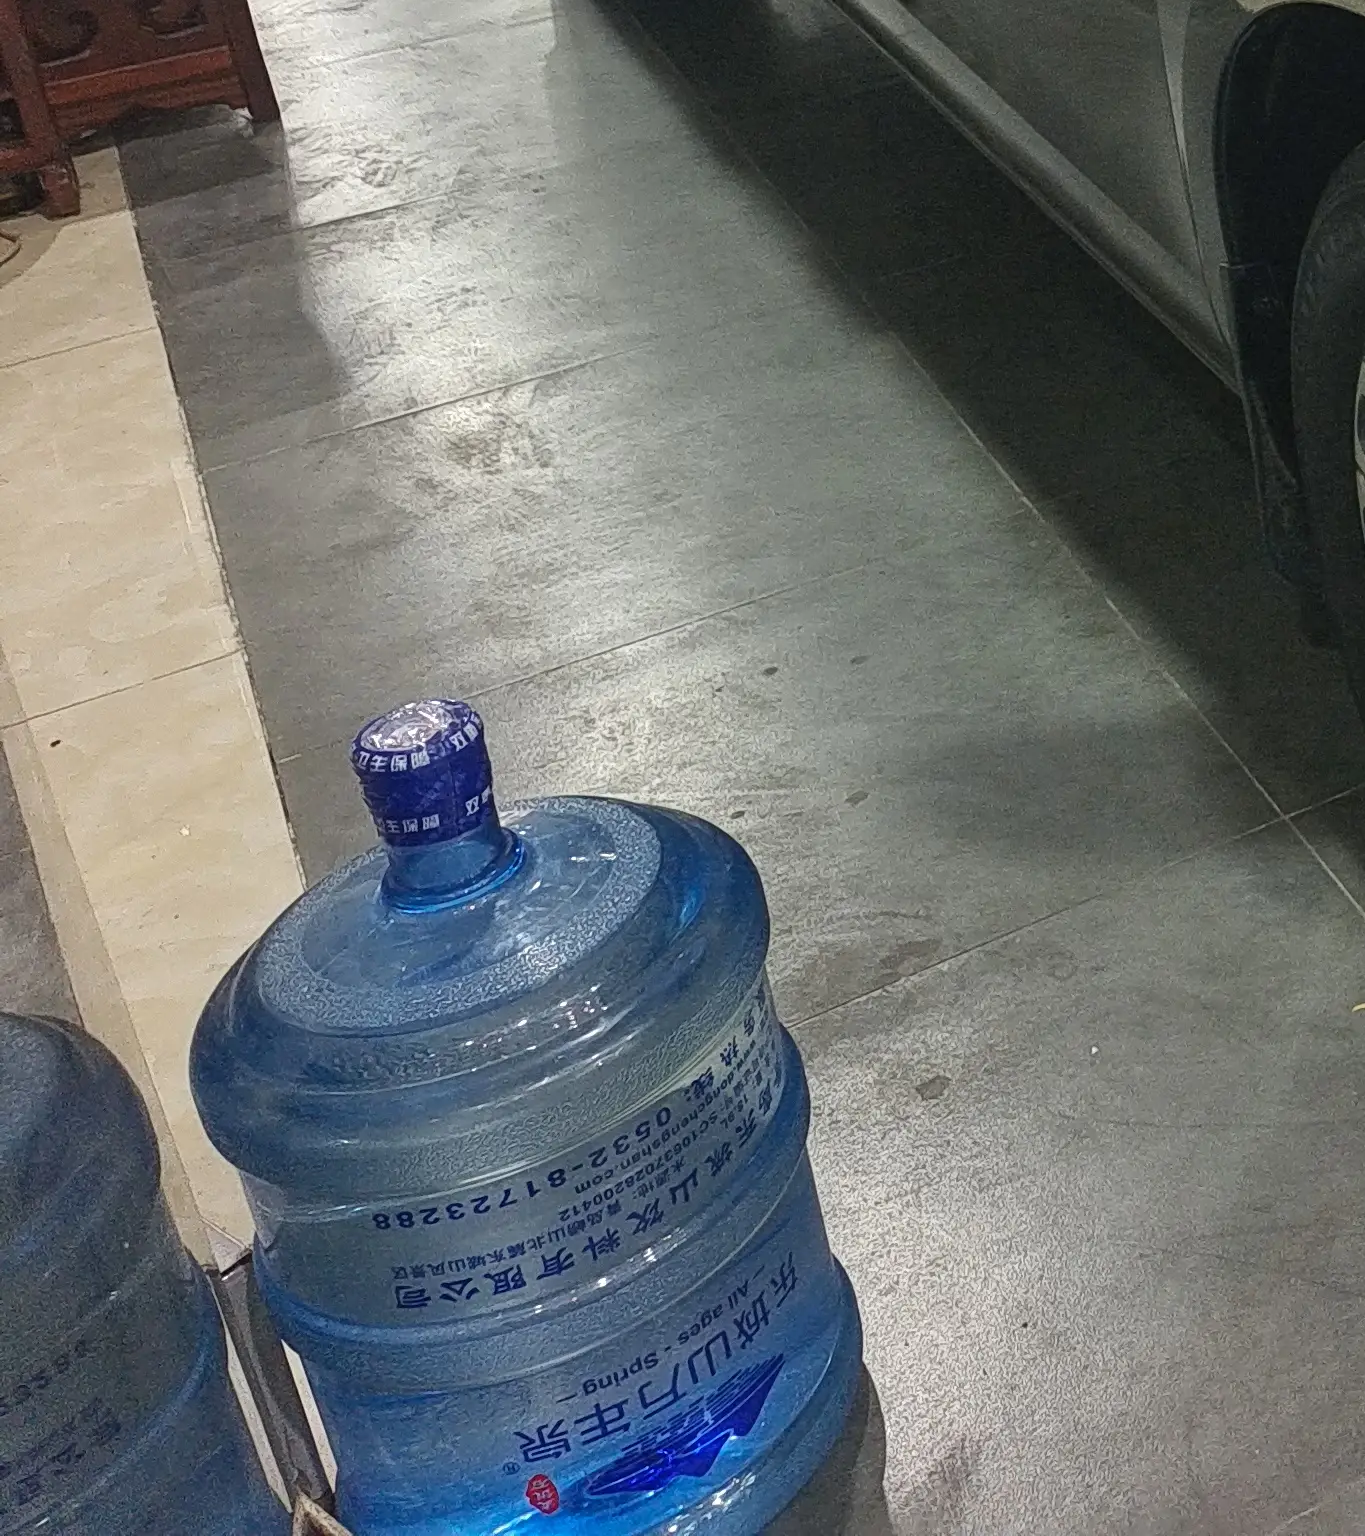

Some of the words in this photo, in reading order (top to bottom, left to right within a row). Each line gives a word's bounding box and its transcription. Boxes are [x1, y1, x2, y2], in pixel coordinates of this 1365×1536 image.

[371, 1106, 672, 1231] 0532-81723288
[728, 1278, 750, 1306] All
[676, 1302, 724, 1346] ages
[513, 1251, 799, 1463] 东城山万年泉
[581, 1351, 660, 1397] Spring
